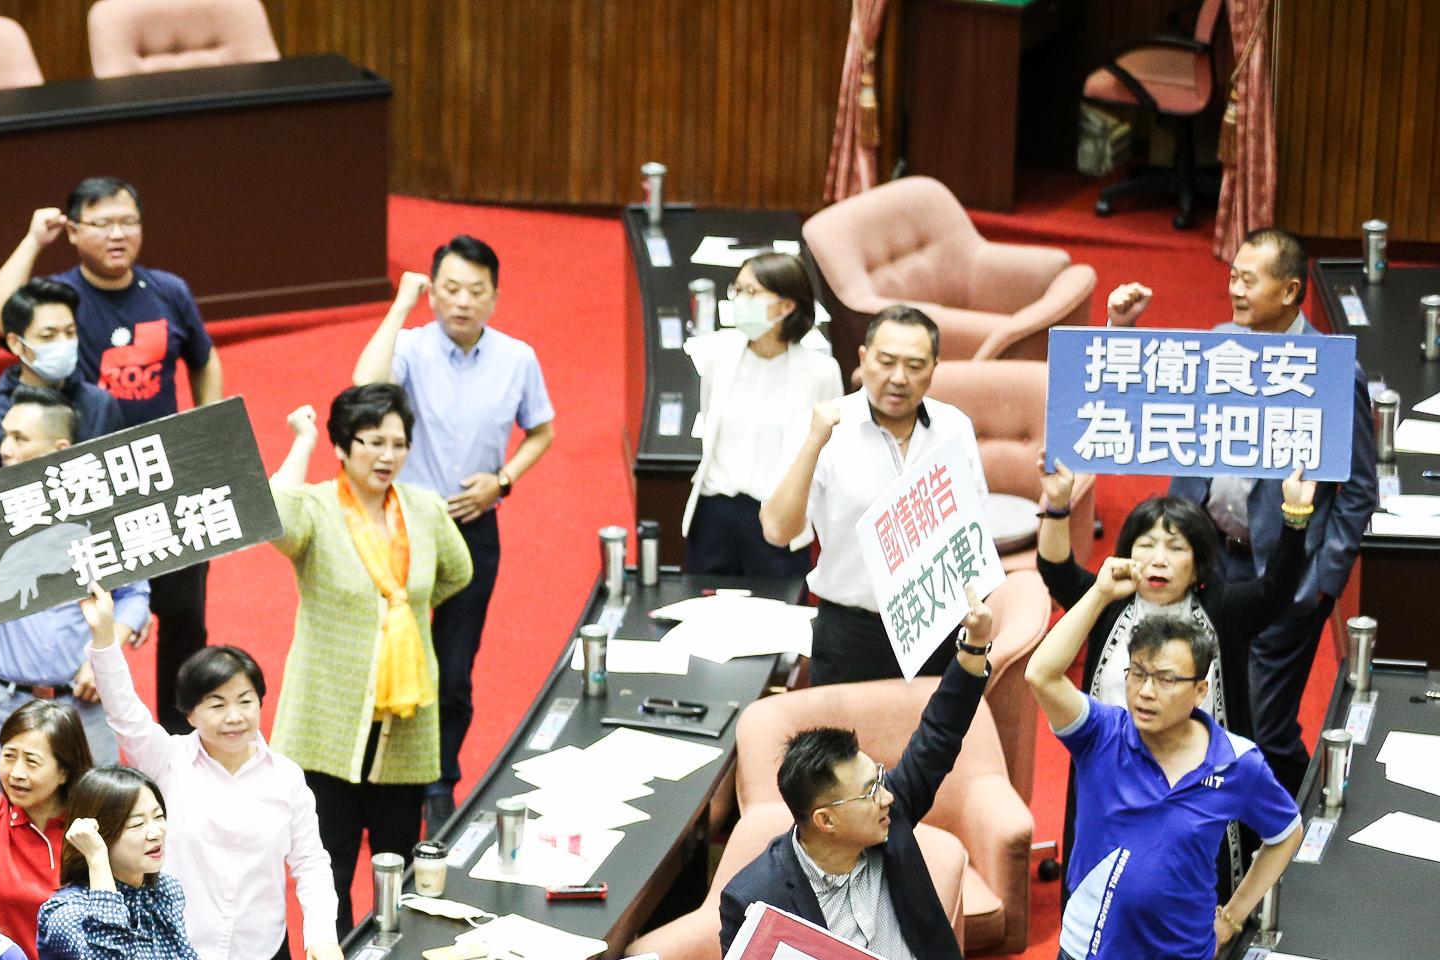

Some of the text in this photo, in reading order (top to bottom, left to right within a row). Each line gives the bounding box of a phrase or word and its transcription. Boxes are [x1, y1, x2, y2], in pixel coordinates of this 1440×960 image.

[1084, 336, 1318, 398] 捍衛食安
[1072, 400, 1323, 471] 為民把關
[67, 485, 243, 587] 拒黑箱
[875, 464, 958, 576] 國情報告
[886, 521, 987, 656] 蔡英文不要?
[1095, 889, 1115, 929] MOVING
[1108, 848, 1131, 889] TAIWAN
